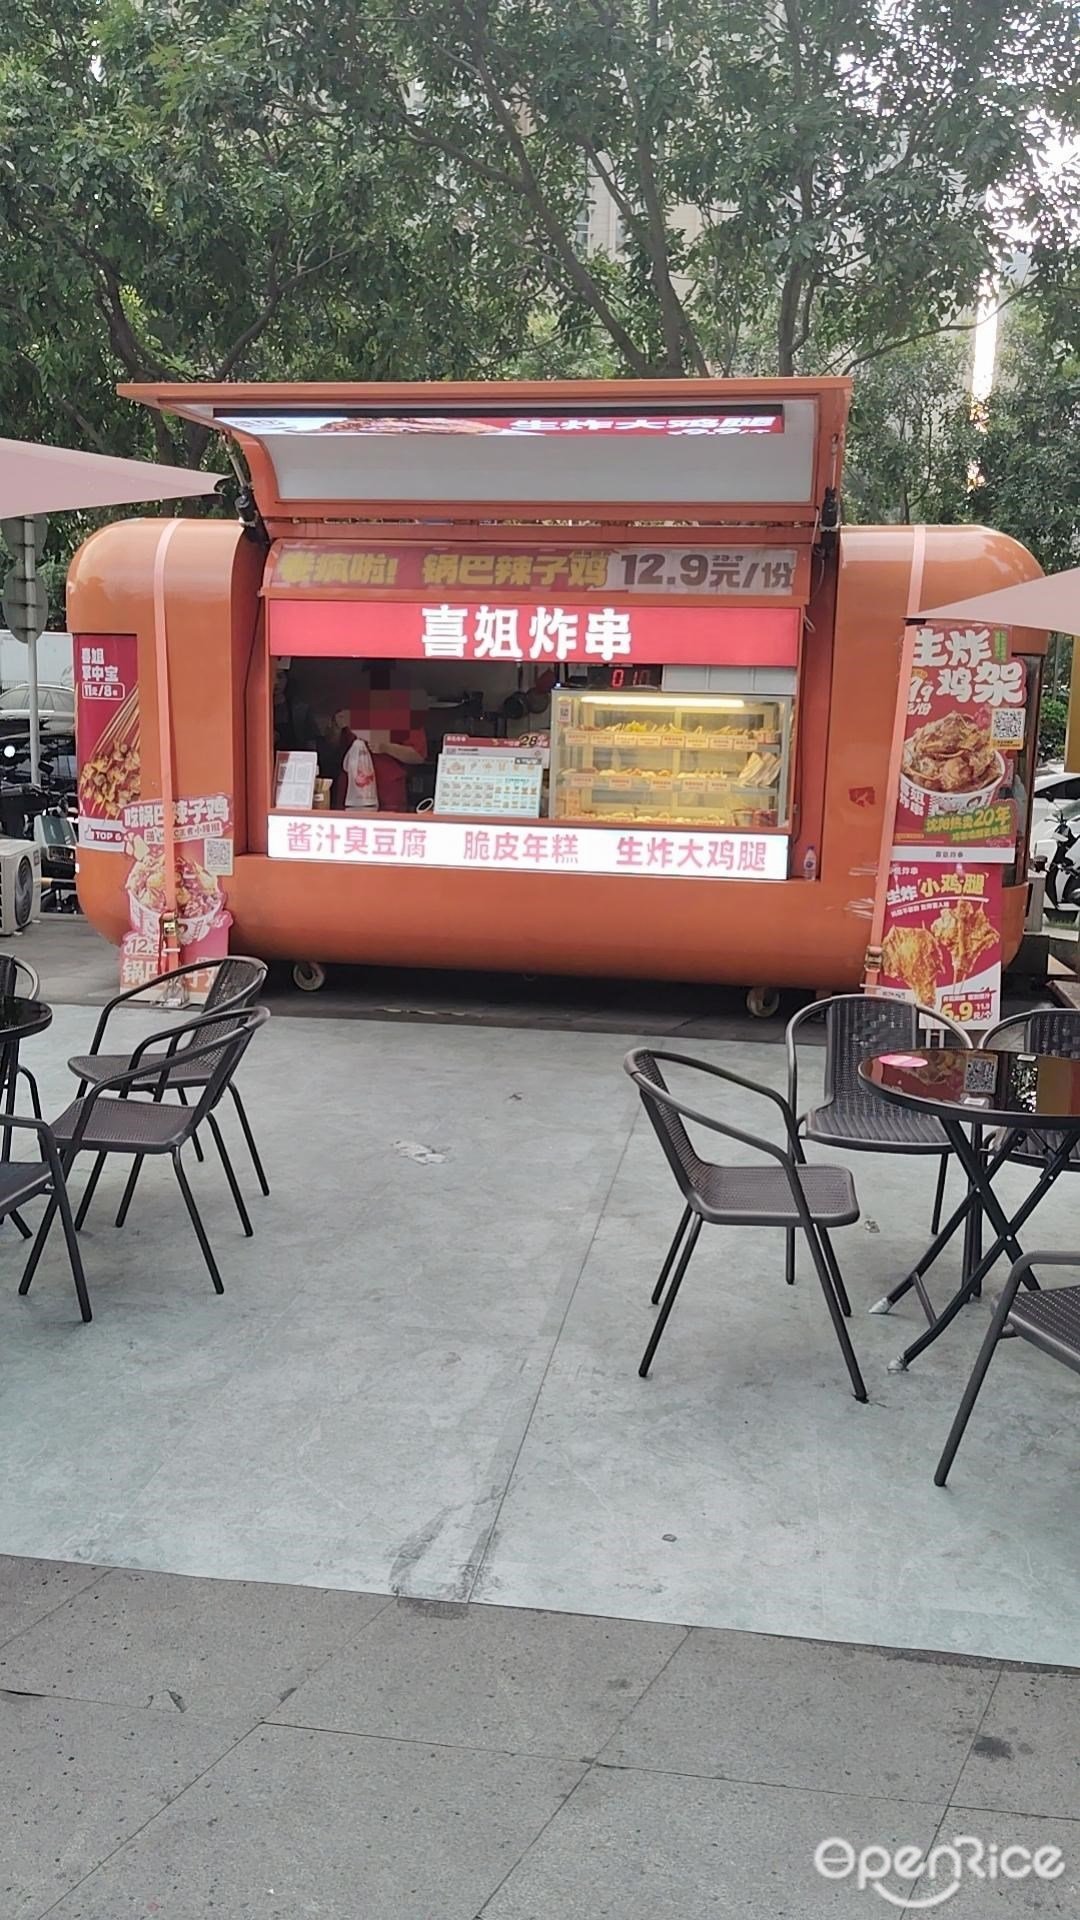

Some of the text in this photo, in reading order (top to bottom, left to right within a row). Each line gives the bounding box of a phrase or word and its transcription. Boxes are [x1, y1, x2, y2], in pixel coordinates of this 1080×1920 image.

[510, 417, 776, 430] 生炸大鸡腿
[423, 553, 608, 586] 锅巴辣子鸡
[421, 606, 632, 661] 喜姐炸串
[936, 662, 1026, 706] 鸡架
[95, 830, 112, 840] TOP
[286, 821, 767, 873] 酱汁臭豆腐 脆皮年糕 生炸大鸡腿
[942, 1002, 973, 1021] 6.9
